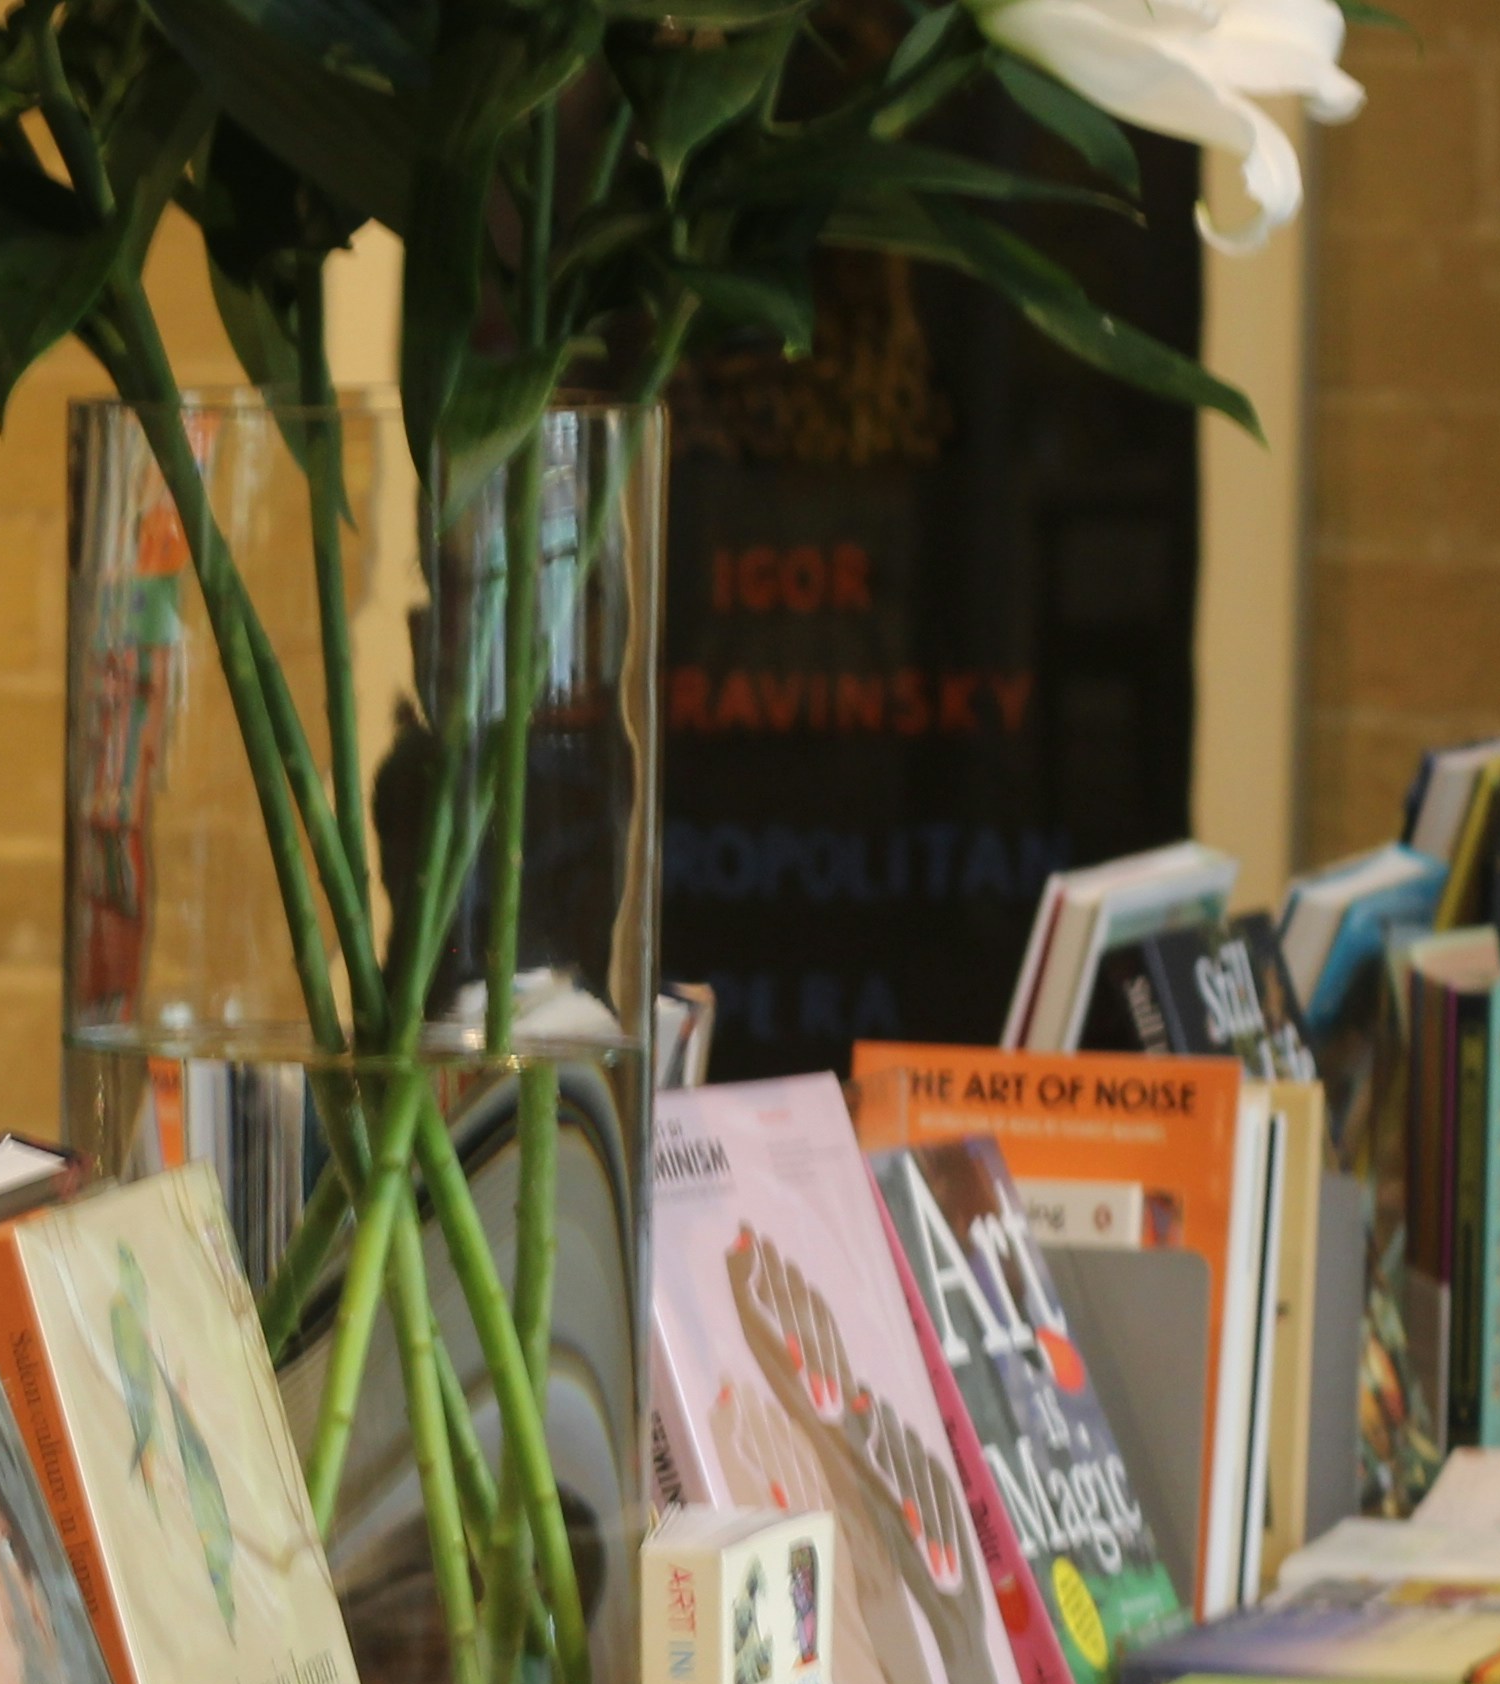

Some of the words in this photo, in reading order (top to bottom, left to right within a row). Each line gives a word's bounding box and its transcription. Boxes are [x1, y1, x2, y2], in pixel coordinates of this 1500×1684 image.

[711, 541, 874, 613] IGOR
[664, 664, 1037, 735] RAVINSKY
[959, 1070, 1028, 1107] ART
[1036, 1073, 1087, 1111] OF
[1095, 1076, 1198, 1115] NOISE
[653, 1138, 731, 1187] MINISM
[902, 1148, 1071, 1366] Art
[981, 1442, 1143, 1575] Magic
[667, 1560, 698, 1636] ART
[673, 1639, 696, 1682] IN
